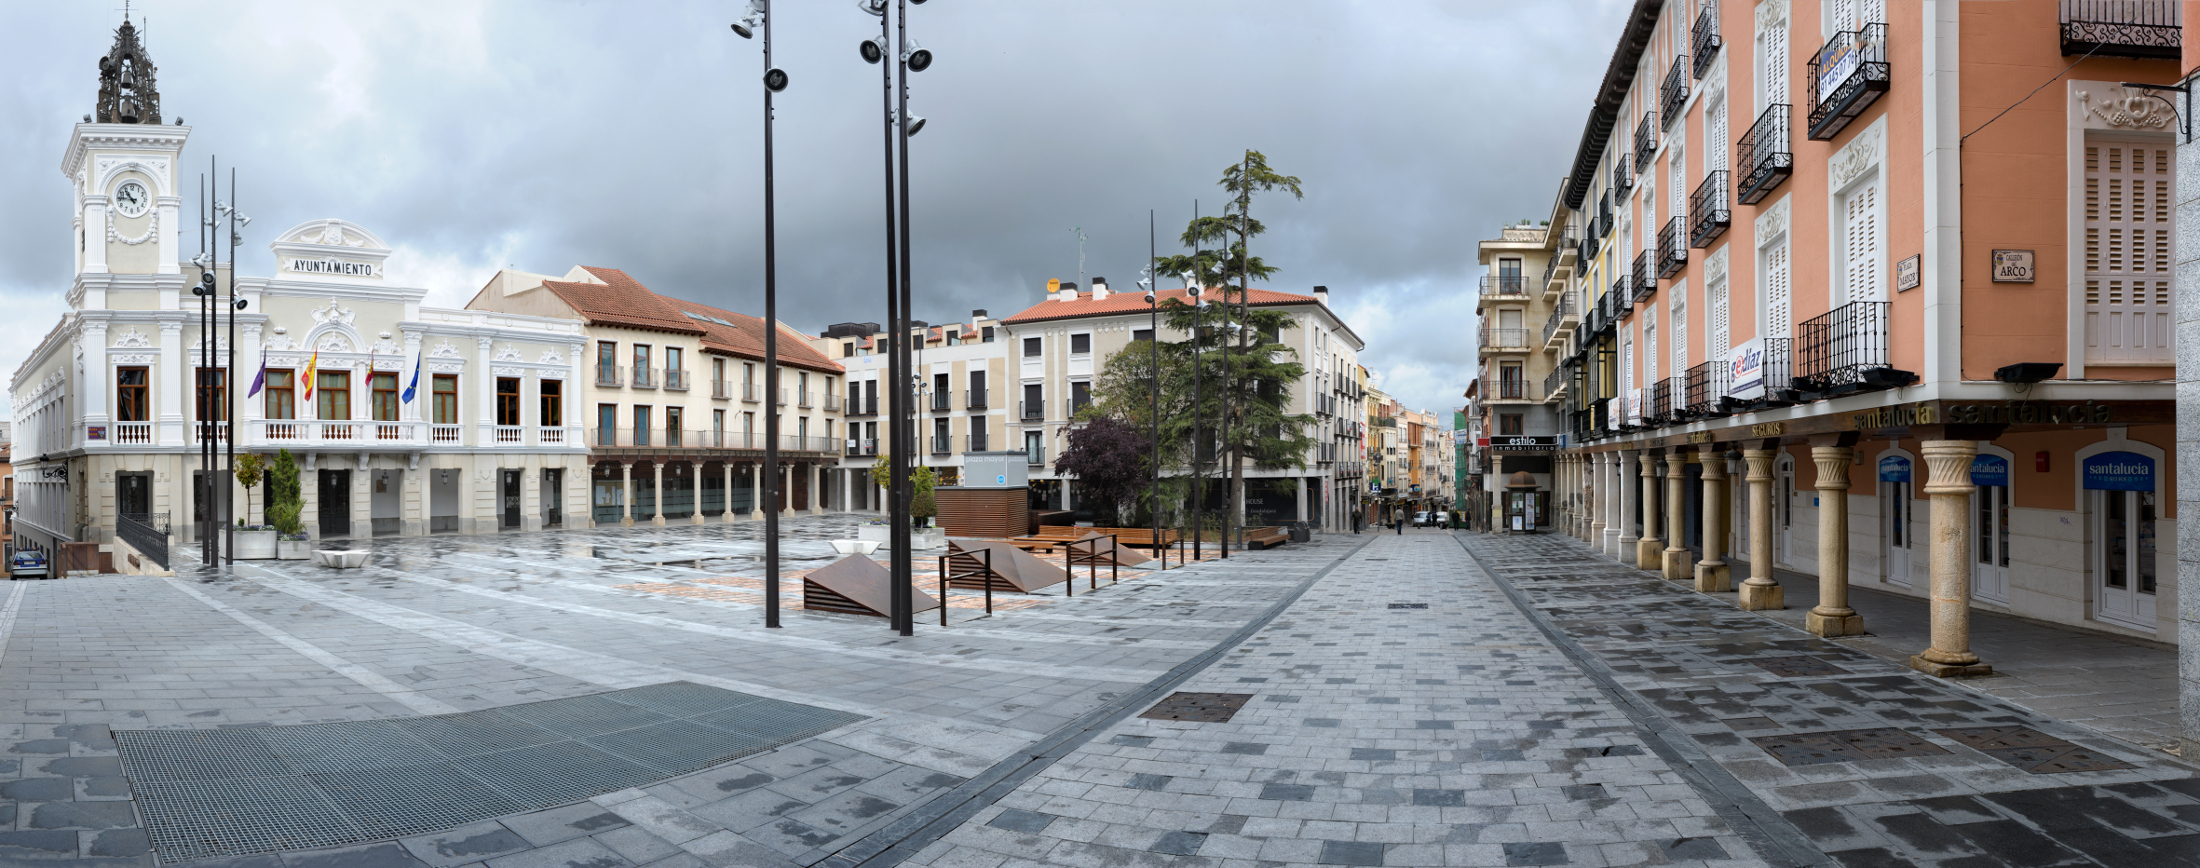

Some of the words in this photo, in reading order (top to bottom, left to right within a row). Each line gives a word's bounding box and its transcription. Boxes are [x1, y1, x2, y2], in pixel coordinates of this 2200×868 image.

[294, 260, 372, 276] AYUNTAMIENTO
[2000, 266, 2027, 277] ARCO
[1853, 402, 1934, 430] santalucía
[1752, 422, 1781, 437] SEGUROS
[1509, 436, 1536, 445] estilo
[1970, 463, 2005, 473] antalucía
[2089, 463, 2149, 475] santalucía
